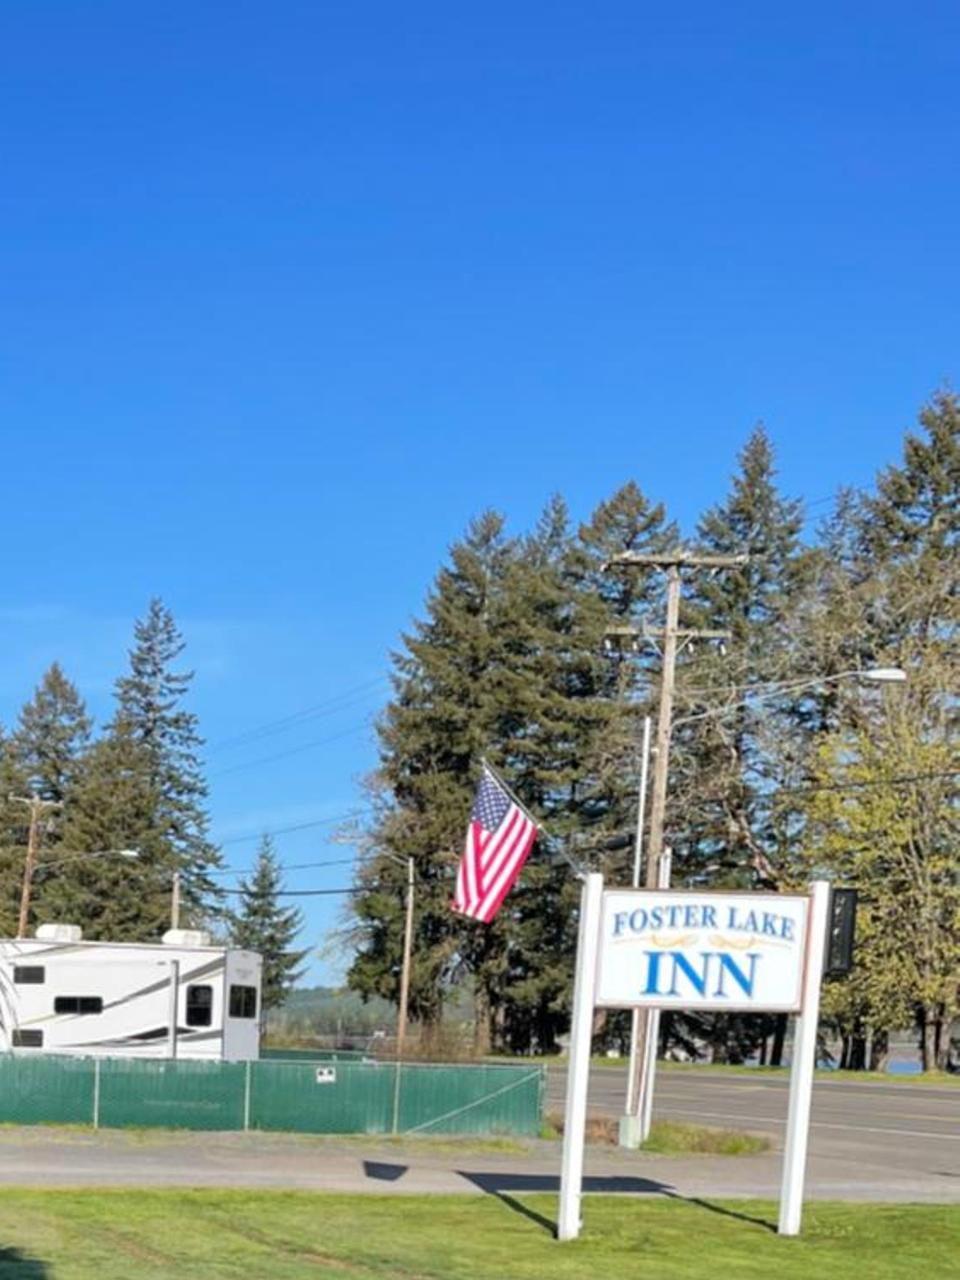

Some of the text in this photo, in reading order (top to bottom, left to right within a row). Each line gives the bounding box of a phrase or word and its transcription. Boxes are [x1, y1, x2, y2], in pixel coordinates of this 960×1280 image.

[612, 904, 795, 942] FOSTER LAKE
[640, 950, 761, 998] INN
